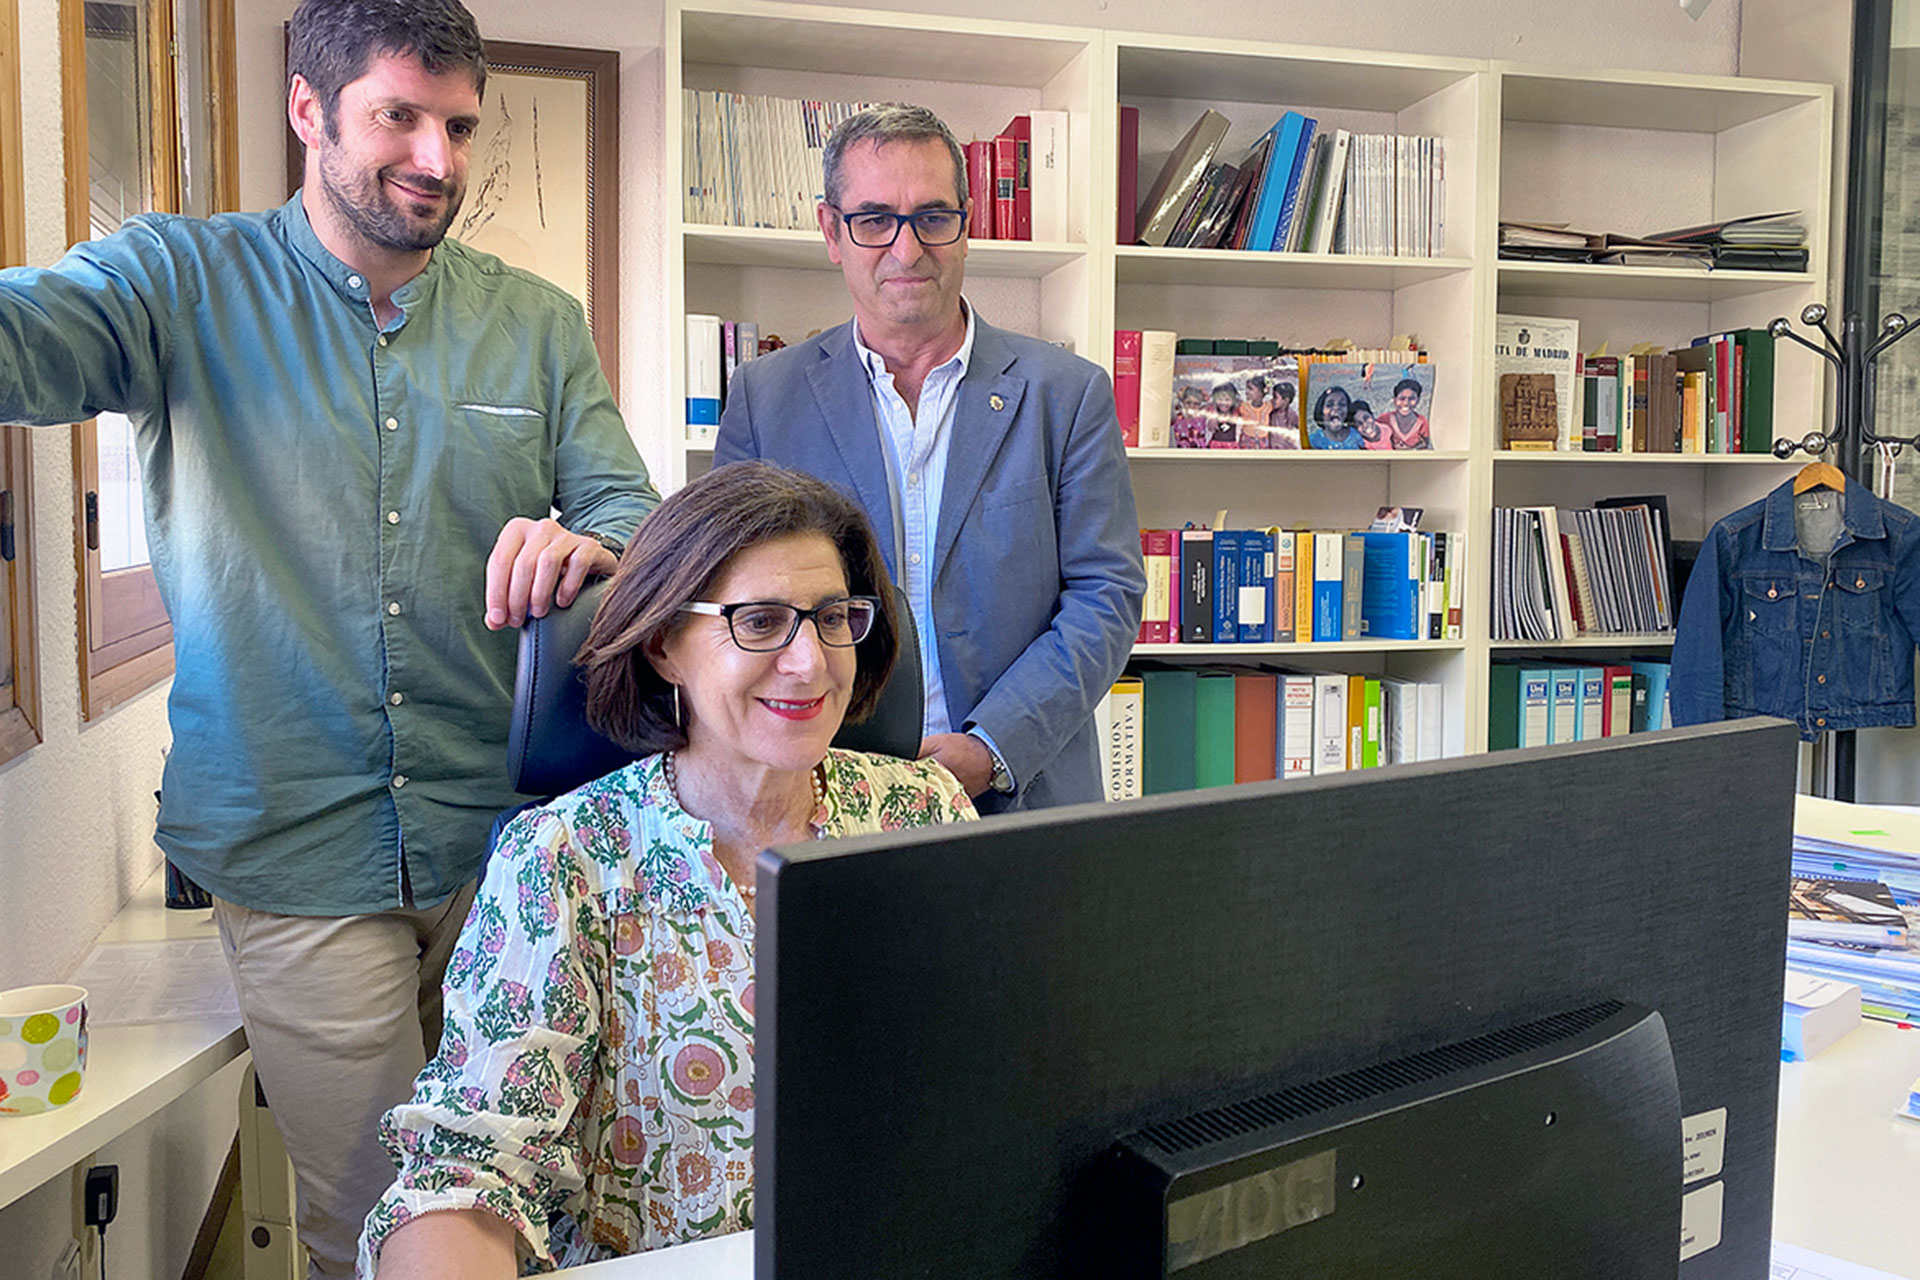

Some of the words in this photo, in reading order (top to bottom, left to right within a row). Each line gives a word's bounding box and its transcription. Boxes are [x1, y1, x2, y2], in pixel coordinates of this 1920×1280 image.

[1516, 346, 1528, 357] DE
[1112, 721, 1121, 801] COMISION
[1125, 703, 1134, 797] FORMATIVA
